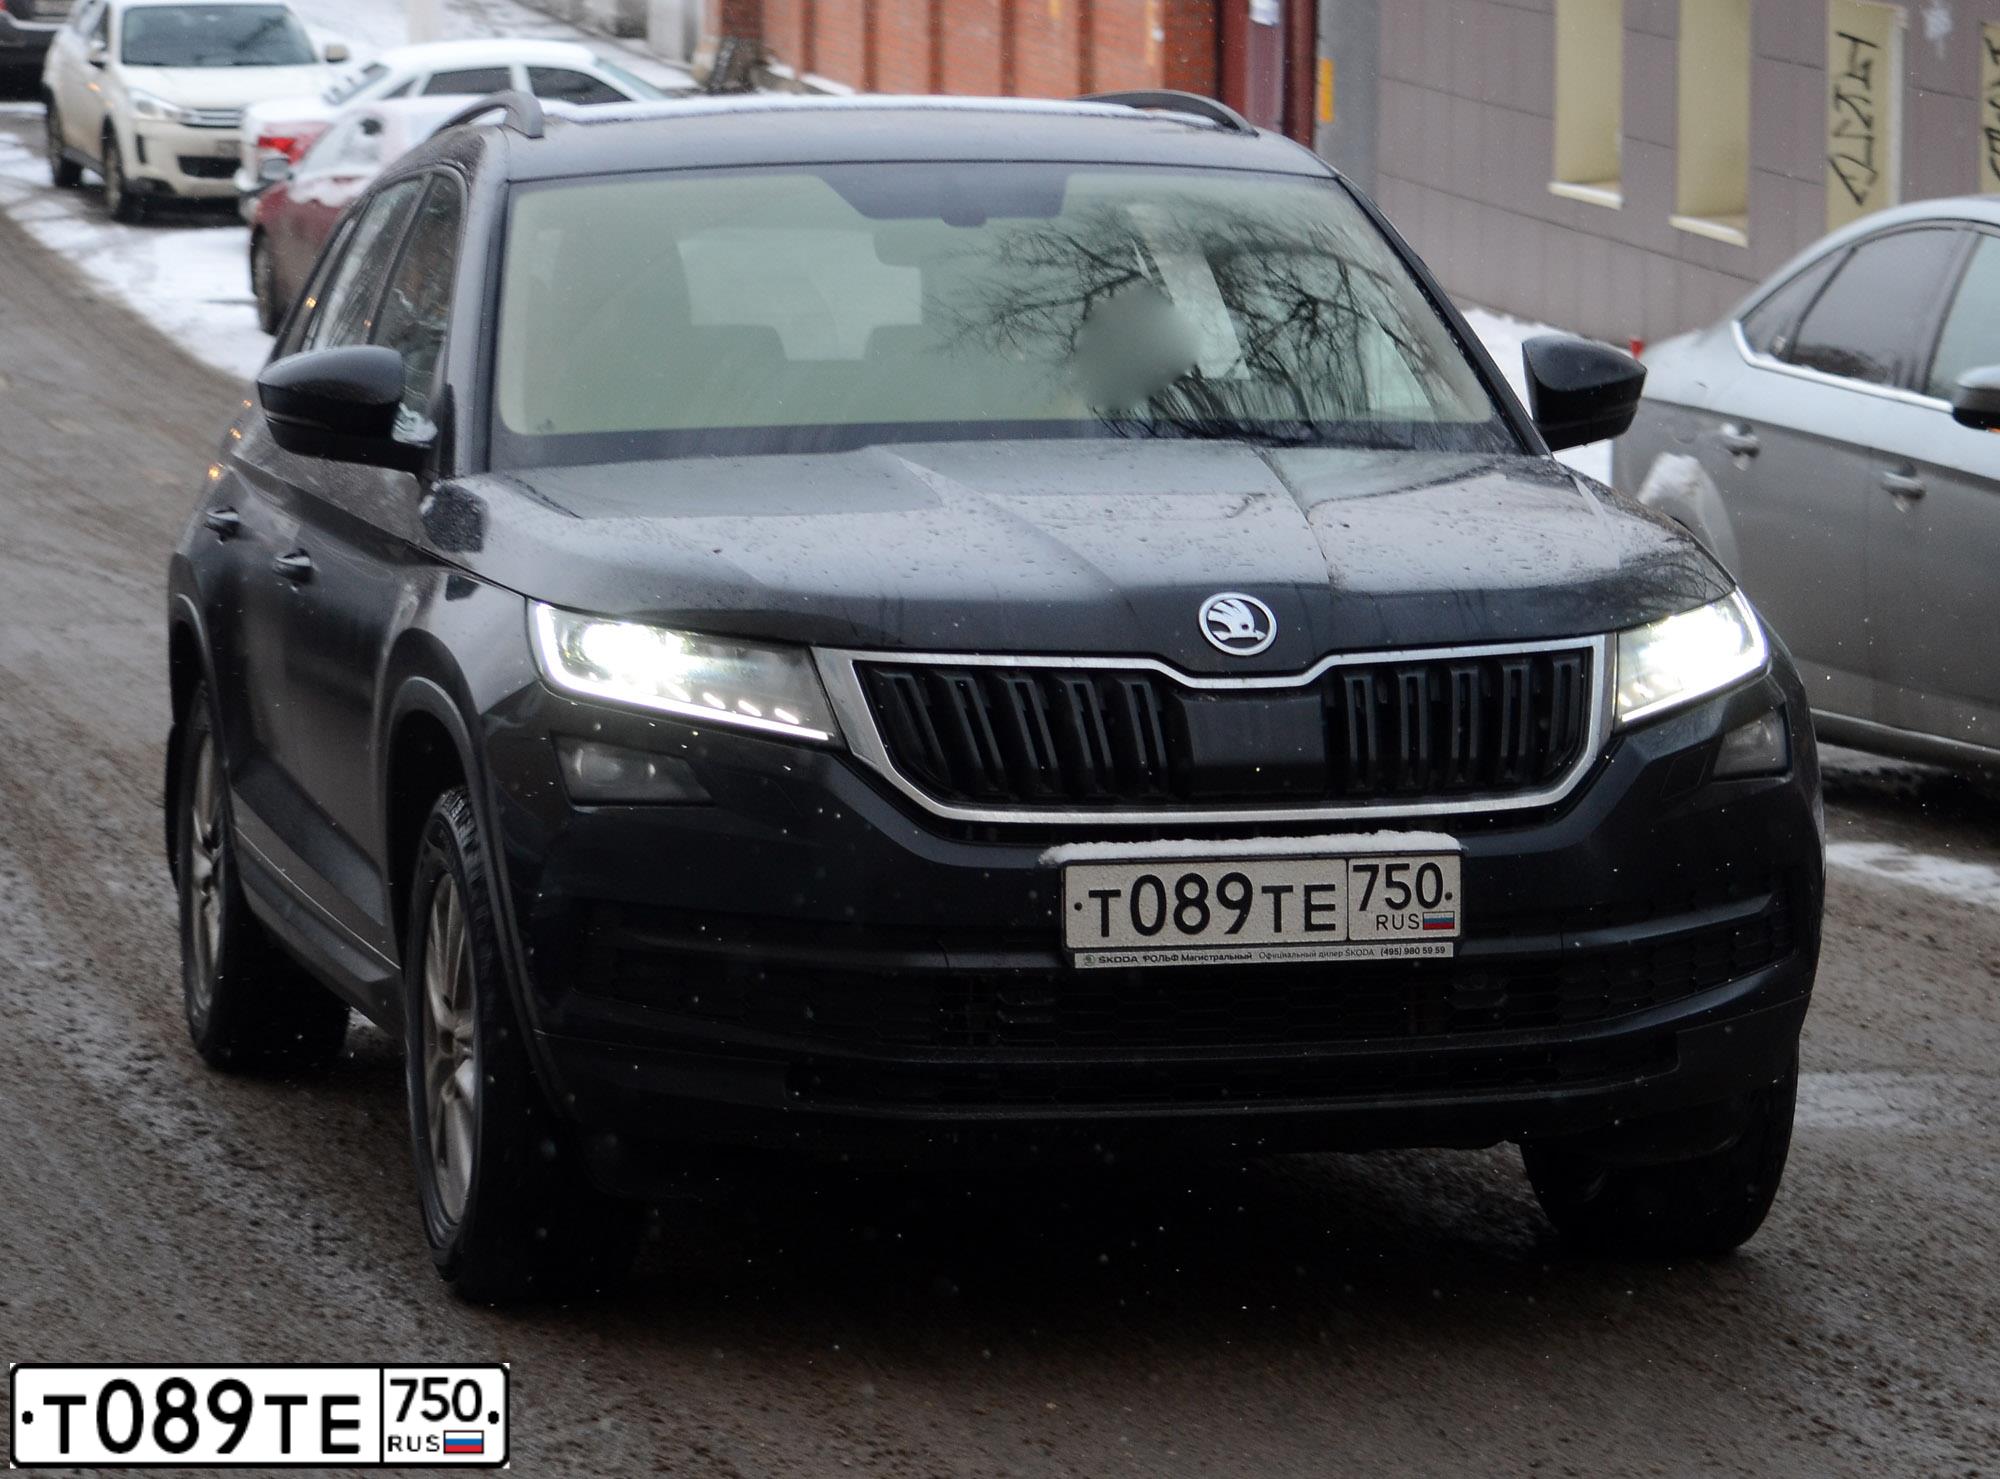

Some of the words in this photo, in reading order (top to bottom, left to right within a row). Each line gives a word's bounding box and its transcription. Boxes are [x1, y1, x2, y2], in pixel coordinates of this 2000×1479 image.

[1352, 861, 1444, 912] 750
[1375, 912, 1421, 931] RUS
[1142, 953, 1179, 964] РОЛЬФ
[1181, 951, 1253, 963] Магистральный
[1318, 949, 1344, 960] дилер
[1380, 946, 1402, 957] (495)
[1403, 946, 1421, 955] 980
[1422, 945, 1434, 955] 59
[1434, 945, 1446, 955] 59
